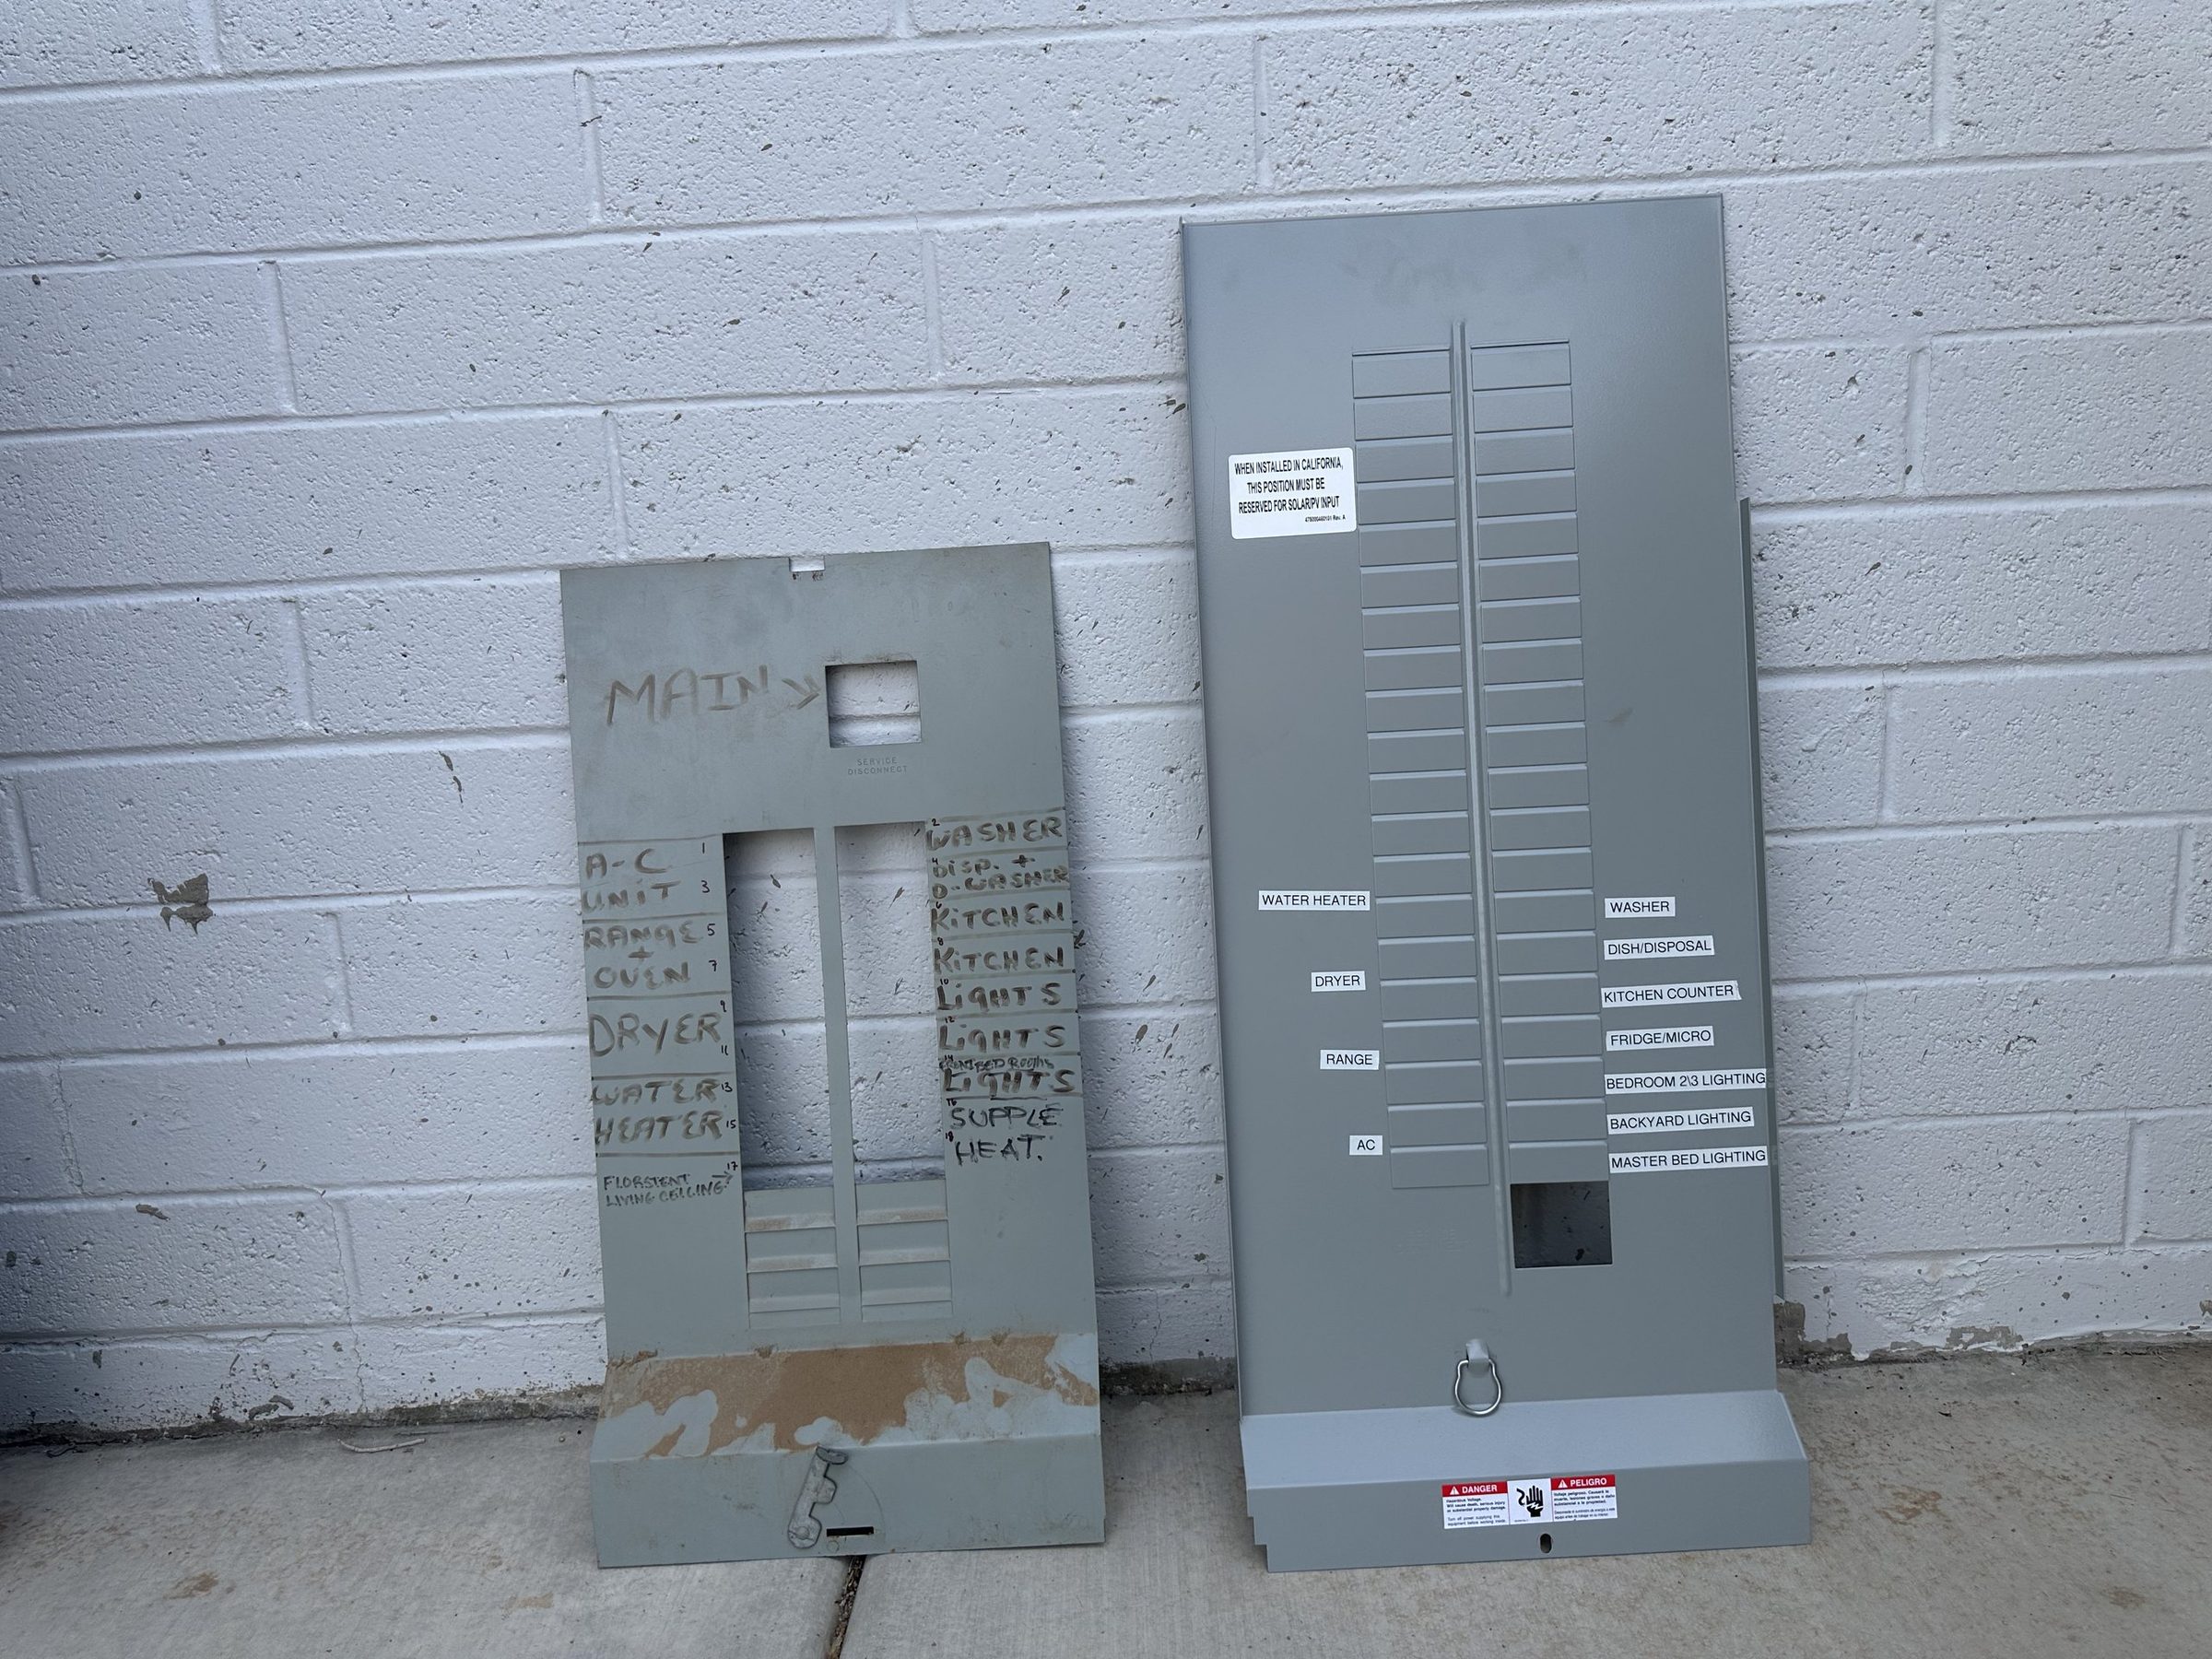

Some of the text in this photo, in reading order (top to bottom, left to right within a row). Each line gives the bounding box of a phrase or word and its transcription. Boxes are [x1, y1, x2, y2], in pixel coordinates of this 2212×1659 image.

[1235, 457, 1344, 475] WHEN INSTALLED IN CALIFORNIA,
[1247, 477, 1325, 494] THIS POSITION MUST BE
[1239, 496, 1340, 513] RESERVED FOR SOLAR/PV INPUT
[606, 665, 770, 726] MAIN
[856, 757, 899, 766] SERVICE
[848, 765, 907, 775] DISCONNECT
[932, 818, 940, 827] 2
[926, 817, 1063, 851] WASHER
[585, 848, 669, 878] A-C
[700, 879, 711, 894] 3
[1262, 895, 1366, 906] WATER HEATER
[1610, 900, 1670, 912] WASHER
[584, 920, 703, 950] RANGE
[707, 923, 715, 936] 5
[936, 936, 944, 947] 8
[1607, 940, 1712, 955] DISH/DISPOSAL
[708, 959, 718, 972] 7
[594, 960, 690, 990] OVEN
[1315, 975, 1360, 987] DRYER
[1604, 984, 1734, 1003] KITCHEN COUNTER
[720, 1000, 727, 1013] 9
[588, 1012, 722, 1057] DRYER
[1611, 1030, 1712, 1046] FRIDGE/MICRO
[1326, 1053, 1373, 1065] RANGE
[721, 1082, 734, 1093] 13
[1606, 1076, 1676, 1089] BEDROOM
[1702, 1072, 1766, 1086] LIGHTING
[591, 1078, 721, 1106] WATER
[725, 1119, 736, 1129] 15
[1610, 1111, 1751, 1130] BACKYARD LIGHTING
[594, 1110, 724, 1146] HEATER
[945, 1132, 955, 1143] 18
[1357, 1139, 1376, 1150] AC
[726, 1161, 738, 1171] 17
[1611, 1149, 1766, 1169] MASTER BED LIGHTING
[1462, 1484, 1498, 1494] DANGER
[1570, 1477, 1607, 1487] PELIGRO
